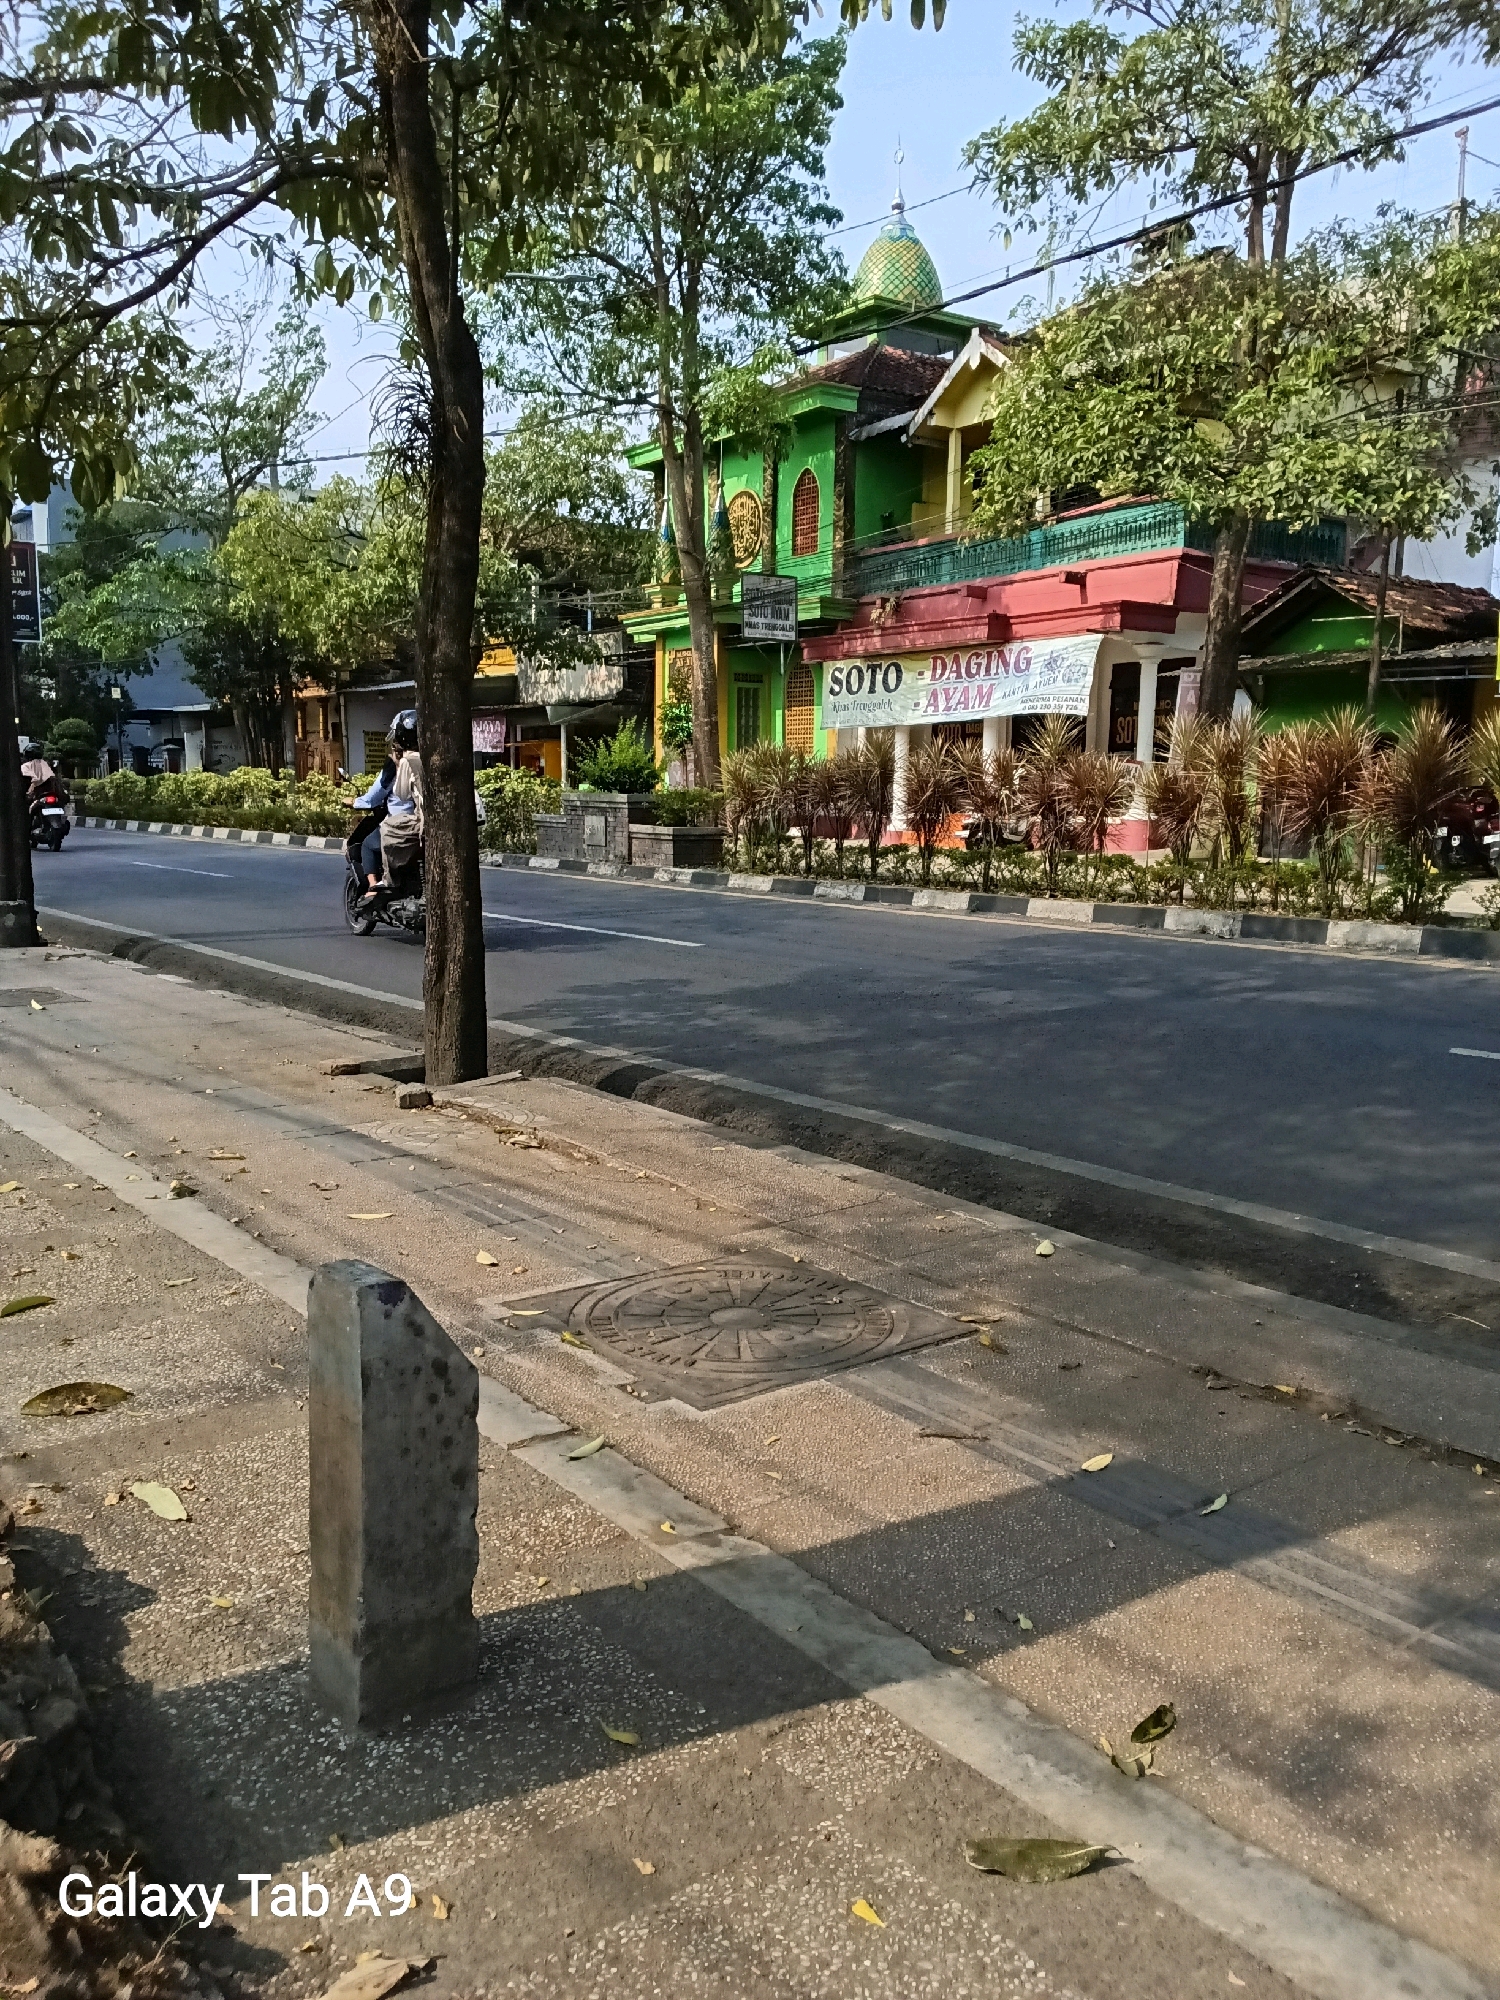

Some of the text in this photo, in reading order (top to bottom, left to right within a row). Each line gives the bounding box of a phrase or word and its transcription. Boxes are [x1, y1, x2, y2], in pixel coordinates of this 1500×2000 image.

[829, 661, 904, 696] SOTO
[930, 645, 1033, 682] DAGING
[922, 683, 996, 714] AYAM
[1052, 696, 1086, 704] PESANAN
